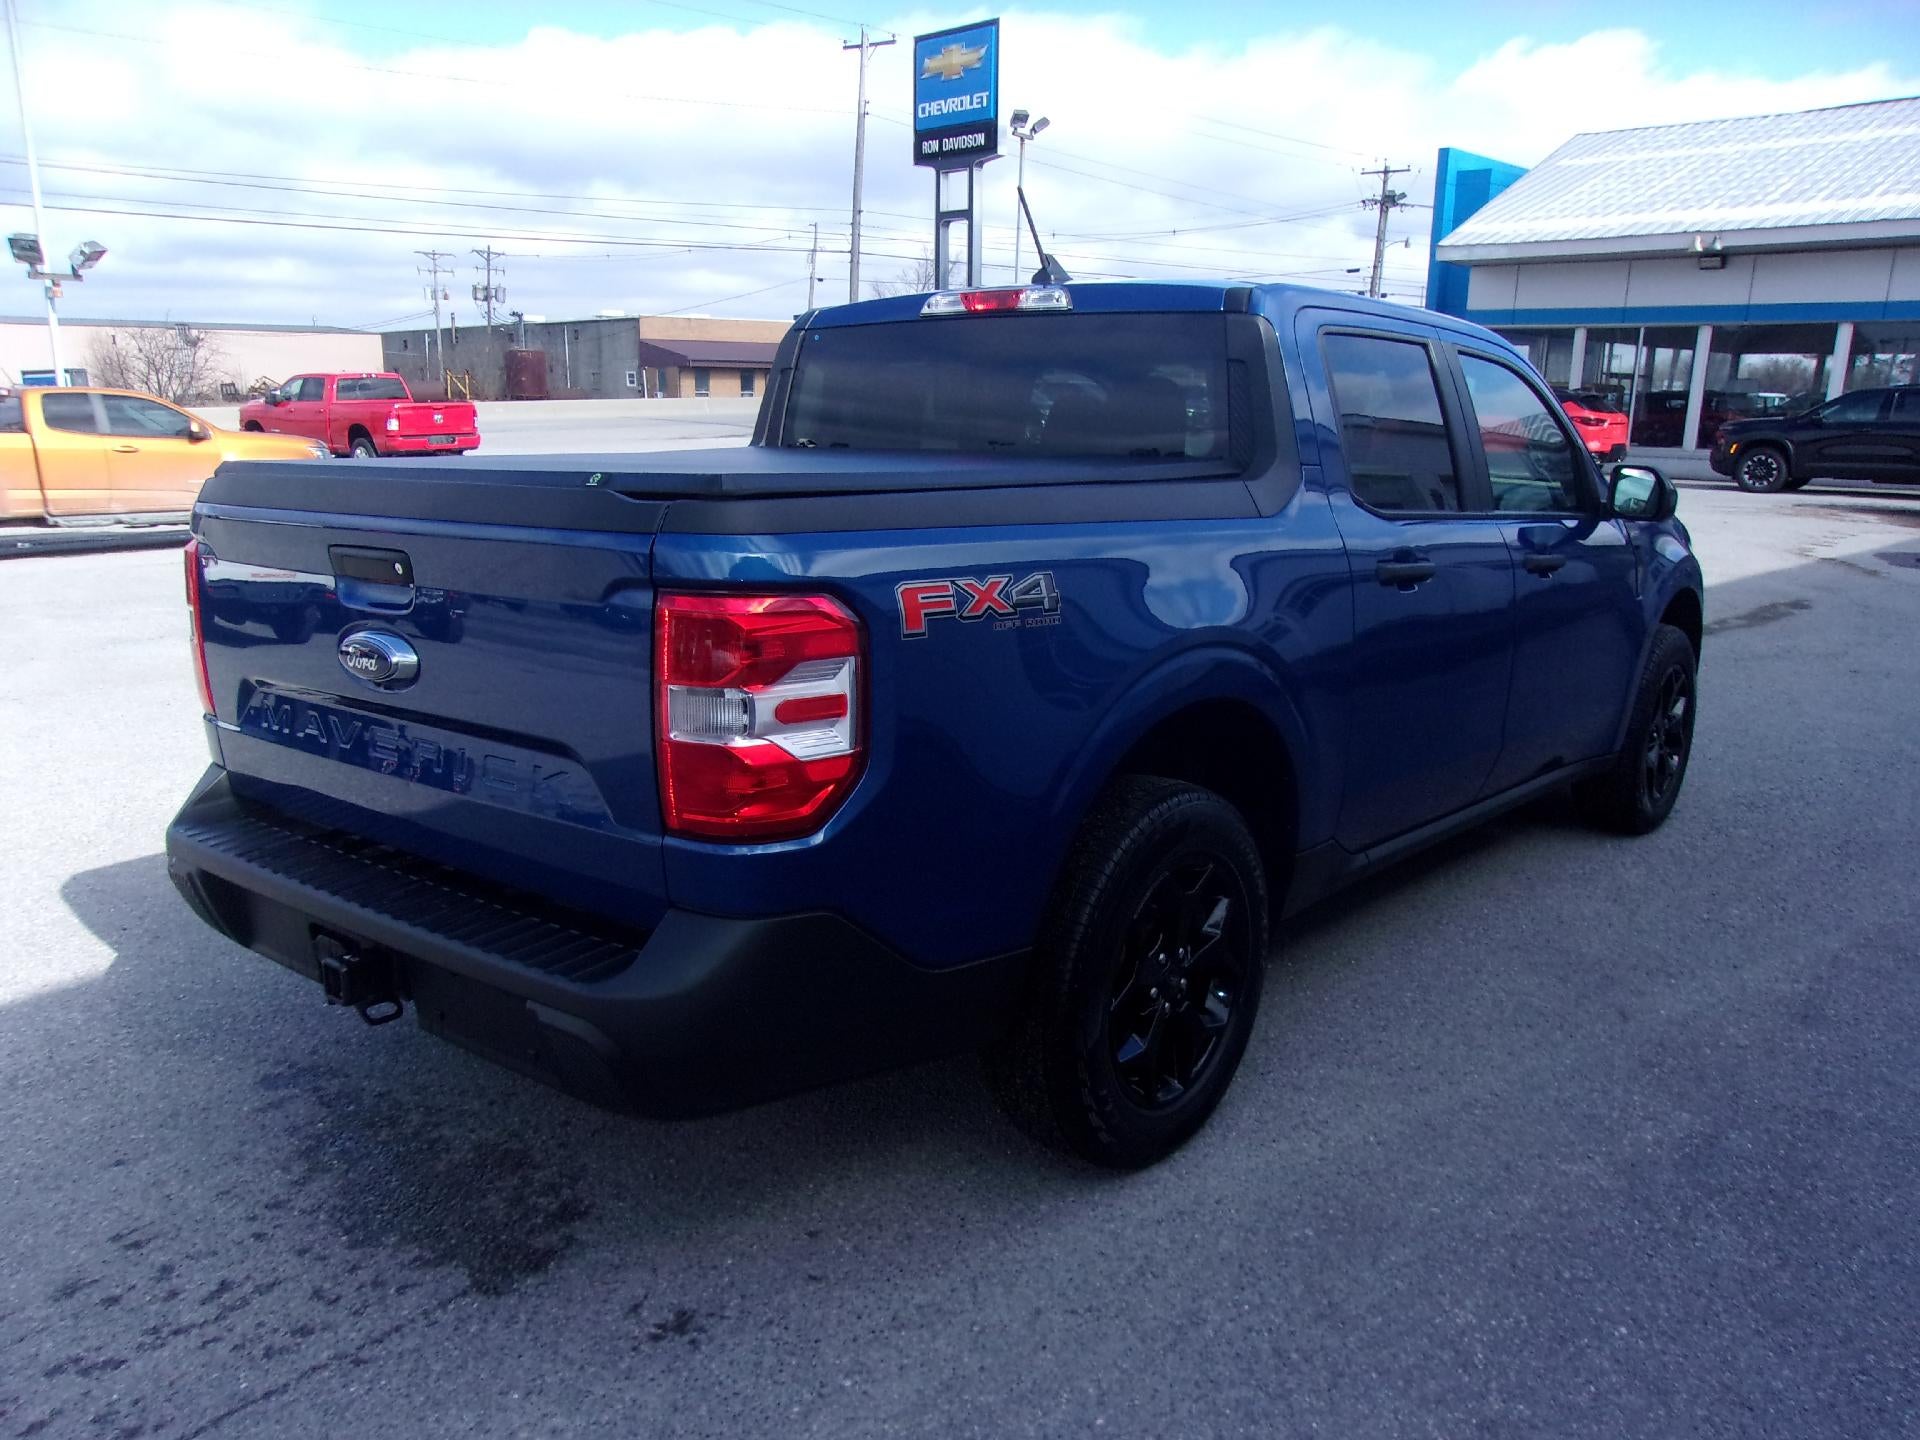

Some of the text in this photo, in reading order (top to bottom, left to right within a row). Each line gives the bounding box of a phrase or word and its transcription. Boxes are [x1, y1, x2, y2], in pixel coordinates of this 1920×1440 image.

[918, 92, 989, 118] CHEVROLET
[922, 133, 985, 154] RON DAVIDSON
[895, 572, 1062, 640] FX4
[346, 644, 378, 671] Ford
